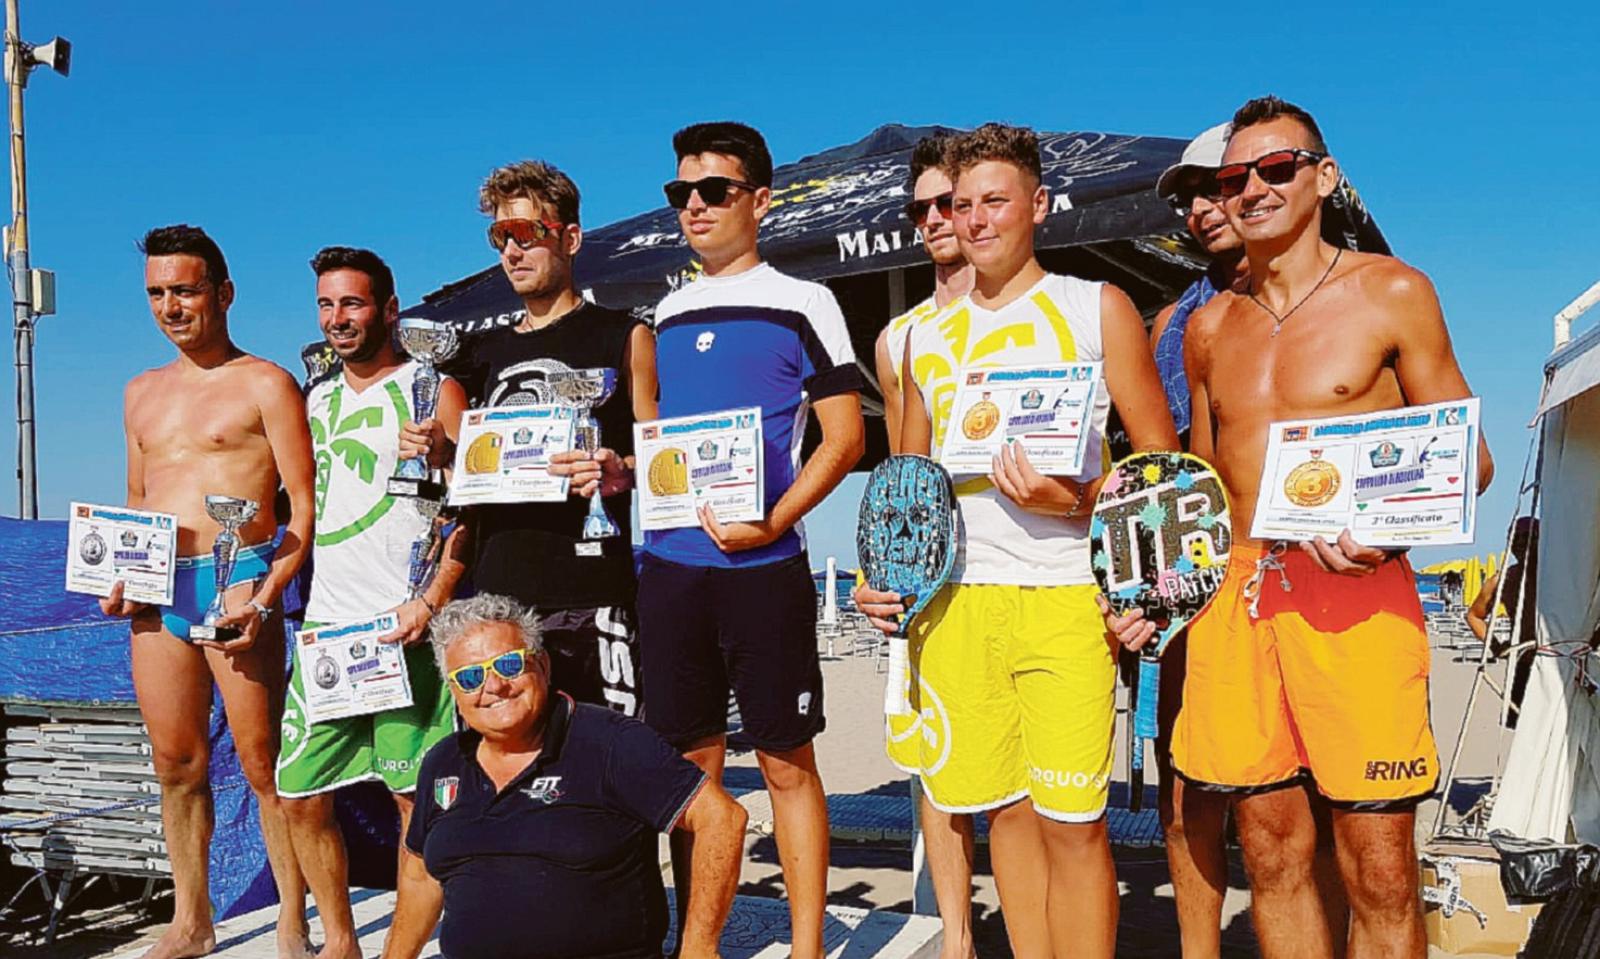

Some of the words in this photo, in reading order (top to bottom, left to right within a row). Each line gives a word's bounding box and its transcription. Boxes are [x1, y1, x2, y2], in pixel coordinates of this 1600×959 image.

[1165, 569, 1223, 602] PATCH
[1374, 757, 1427, 781] RING
[531, 776, 562, 792] FIT
